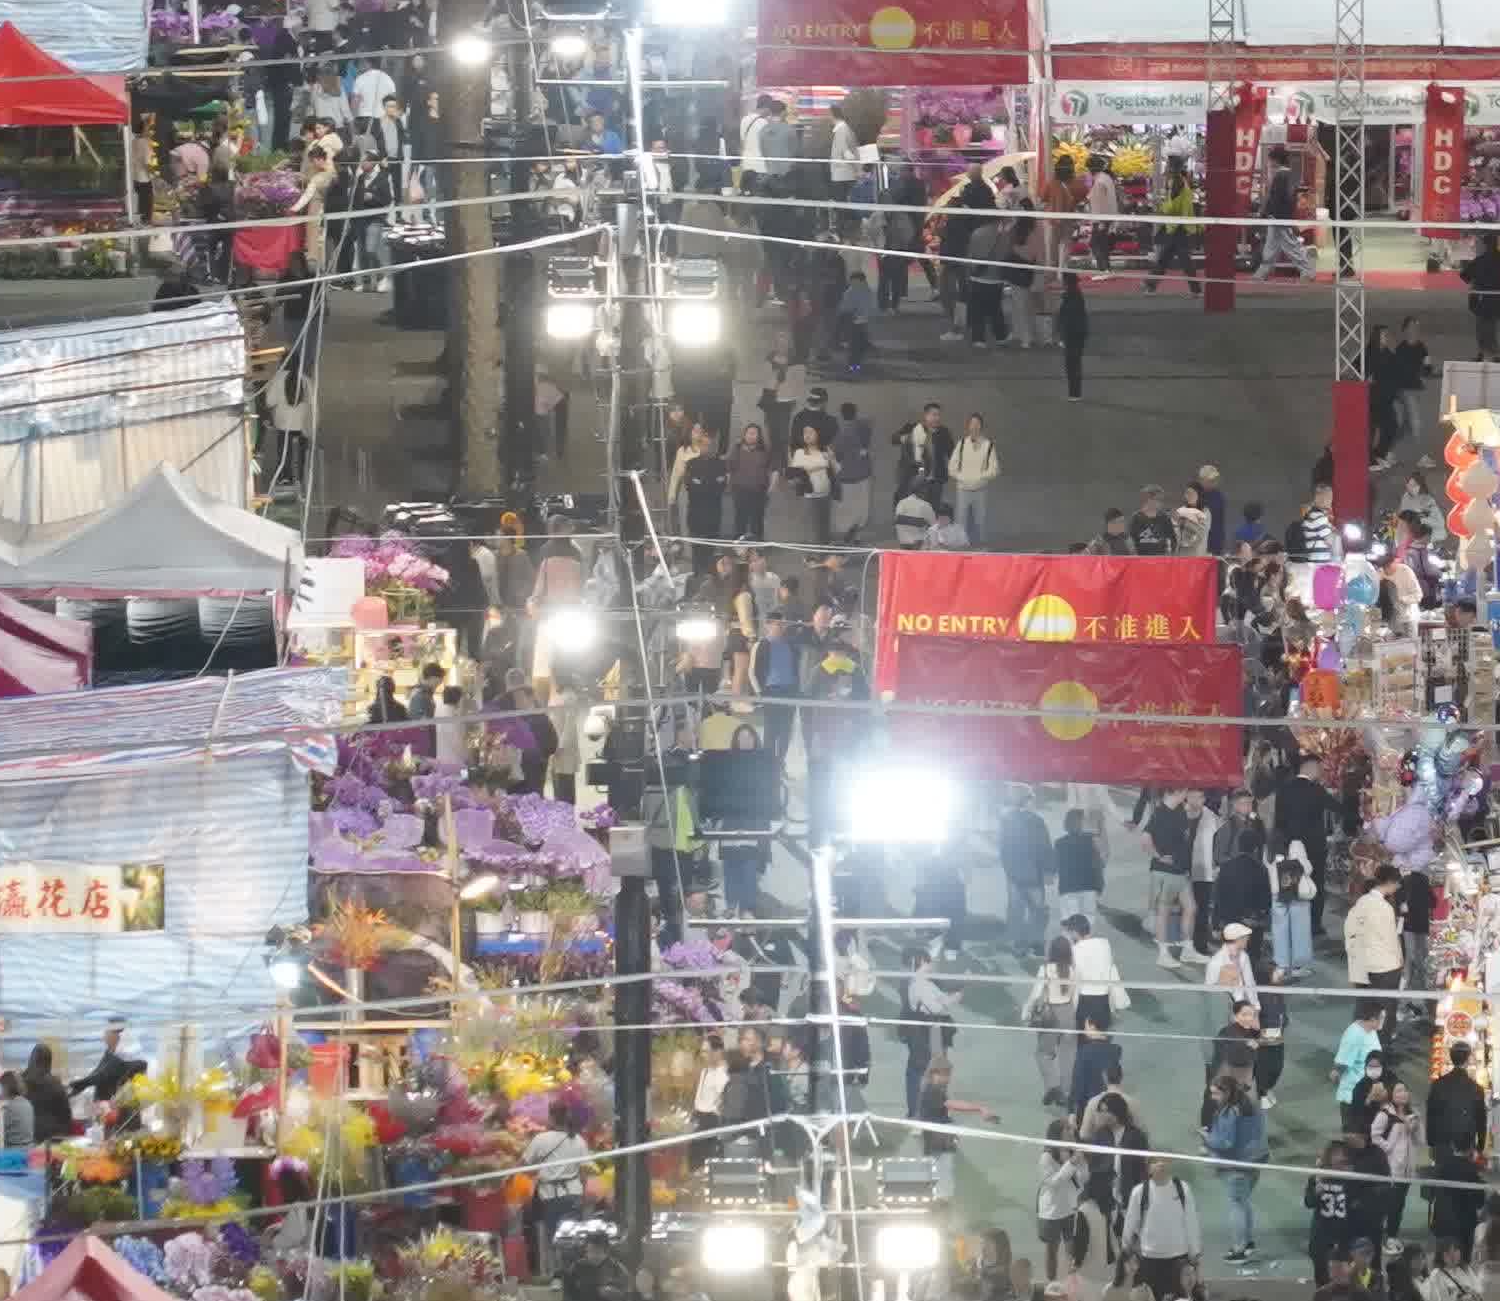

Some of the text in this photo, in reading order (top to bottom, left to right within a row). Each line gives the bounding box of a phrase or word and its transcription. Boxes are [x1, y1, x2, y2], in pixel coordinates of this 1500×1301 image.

[805, 22, 862, 39] ENTRY
[1434, 129, 1454, 195] HDC
[897, 613, 1009, 634] NO ENTRY
[1083, 614, 1201, 640] 不准進入
[1320, 1193, 1347, 1218] 33
